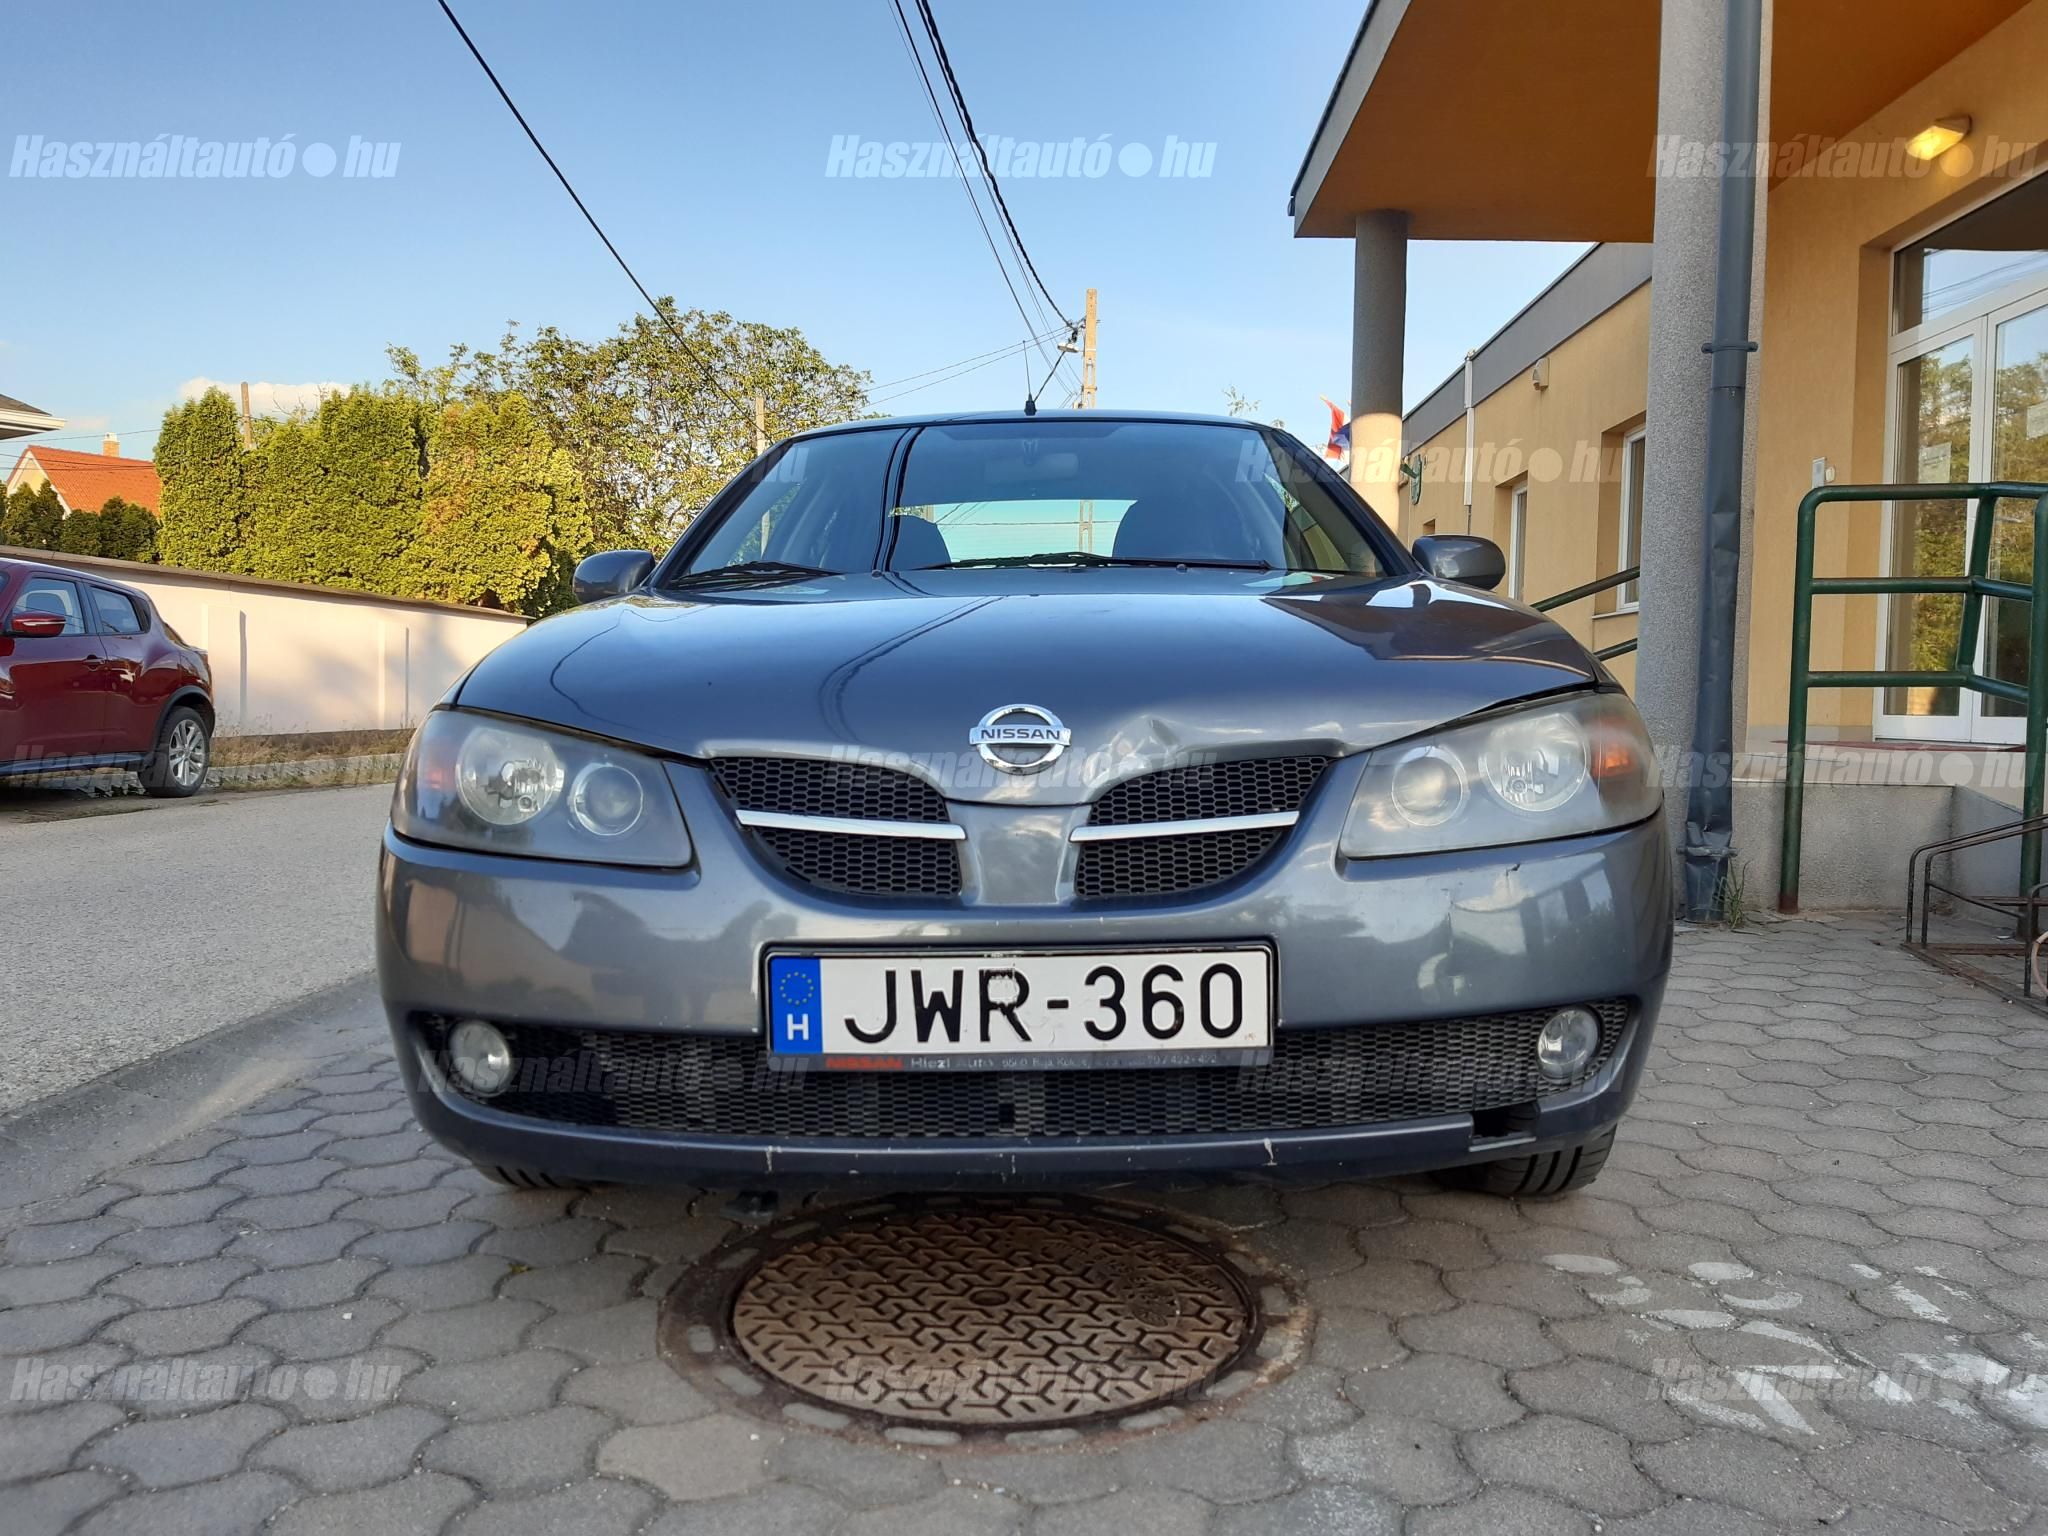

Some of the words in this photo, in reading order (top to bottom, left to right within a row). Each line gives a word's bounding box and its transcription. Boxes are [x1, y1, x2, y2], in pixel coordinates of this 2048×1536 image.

[980, 727, 1061, 741] NISSAN
[786, 1013, 809, 1041] H
[844, 963, 1243, 1044] JWR-360
